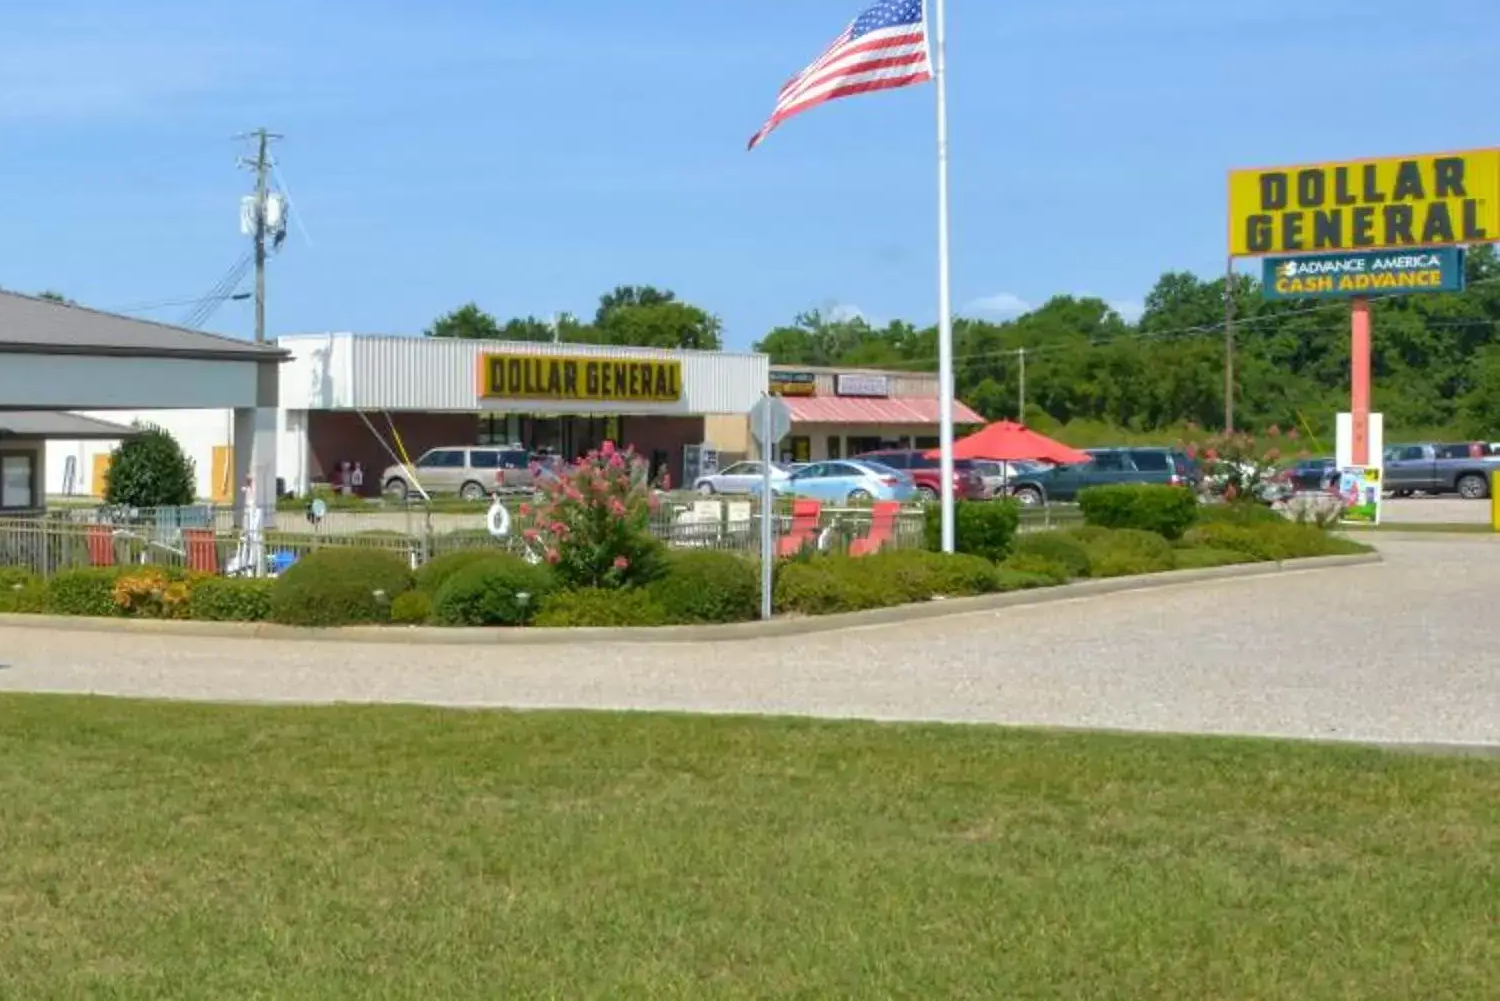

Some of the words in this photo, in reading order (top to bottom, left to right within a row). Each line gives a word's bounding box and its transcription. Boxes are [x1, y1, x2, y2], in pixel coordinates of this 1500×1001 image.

[1260, 157, 1467, 210] DOLLAR
[1246, 199, 1487, 252] GENERAL
[1276, 275, 1333, 293] CASH
[1339, 270, 1442, 291] ADVANCE
[1299, 259, 1365, 274] ADVANCE
[1372, 255, 1441, 270] AMERICA
[490, 358, 578, 395] DOLLAR
[586, 361, 678, 396] GENERAL
